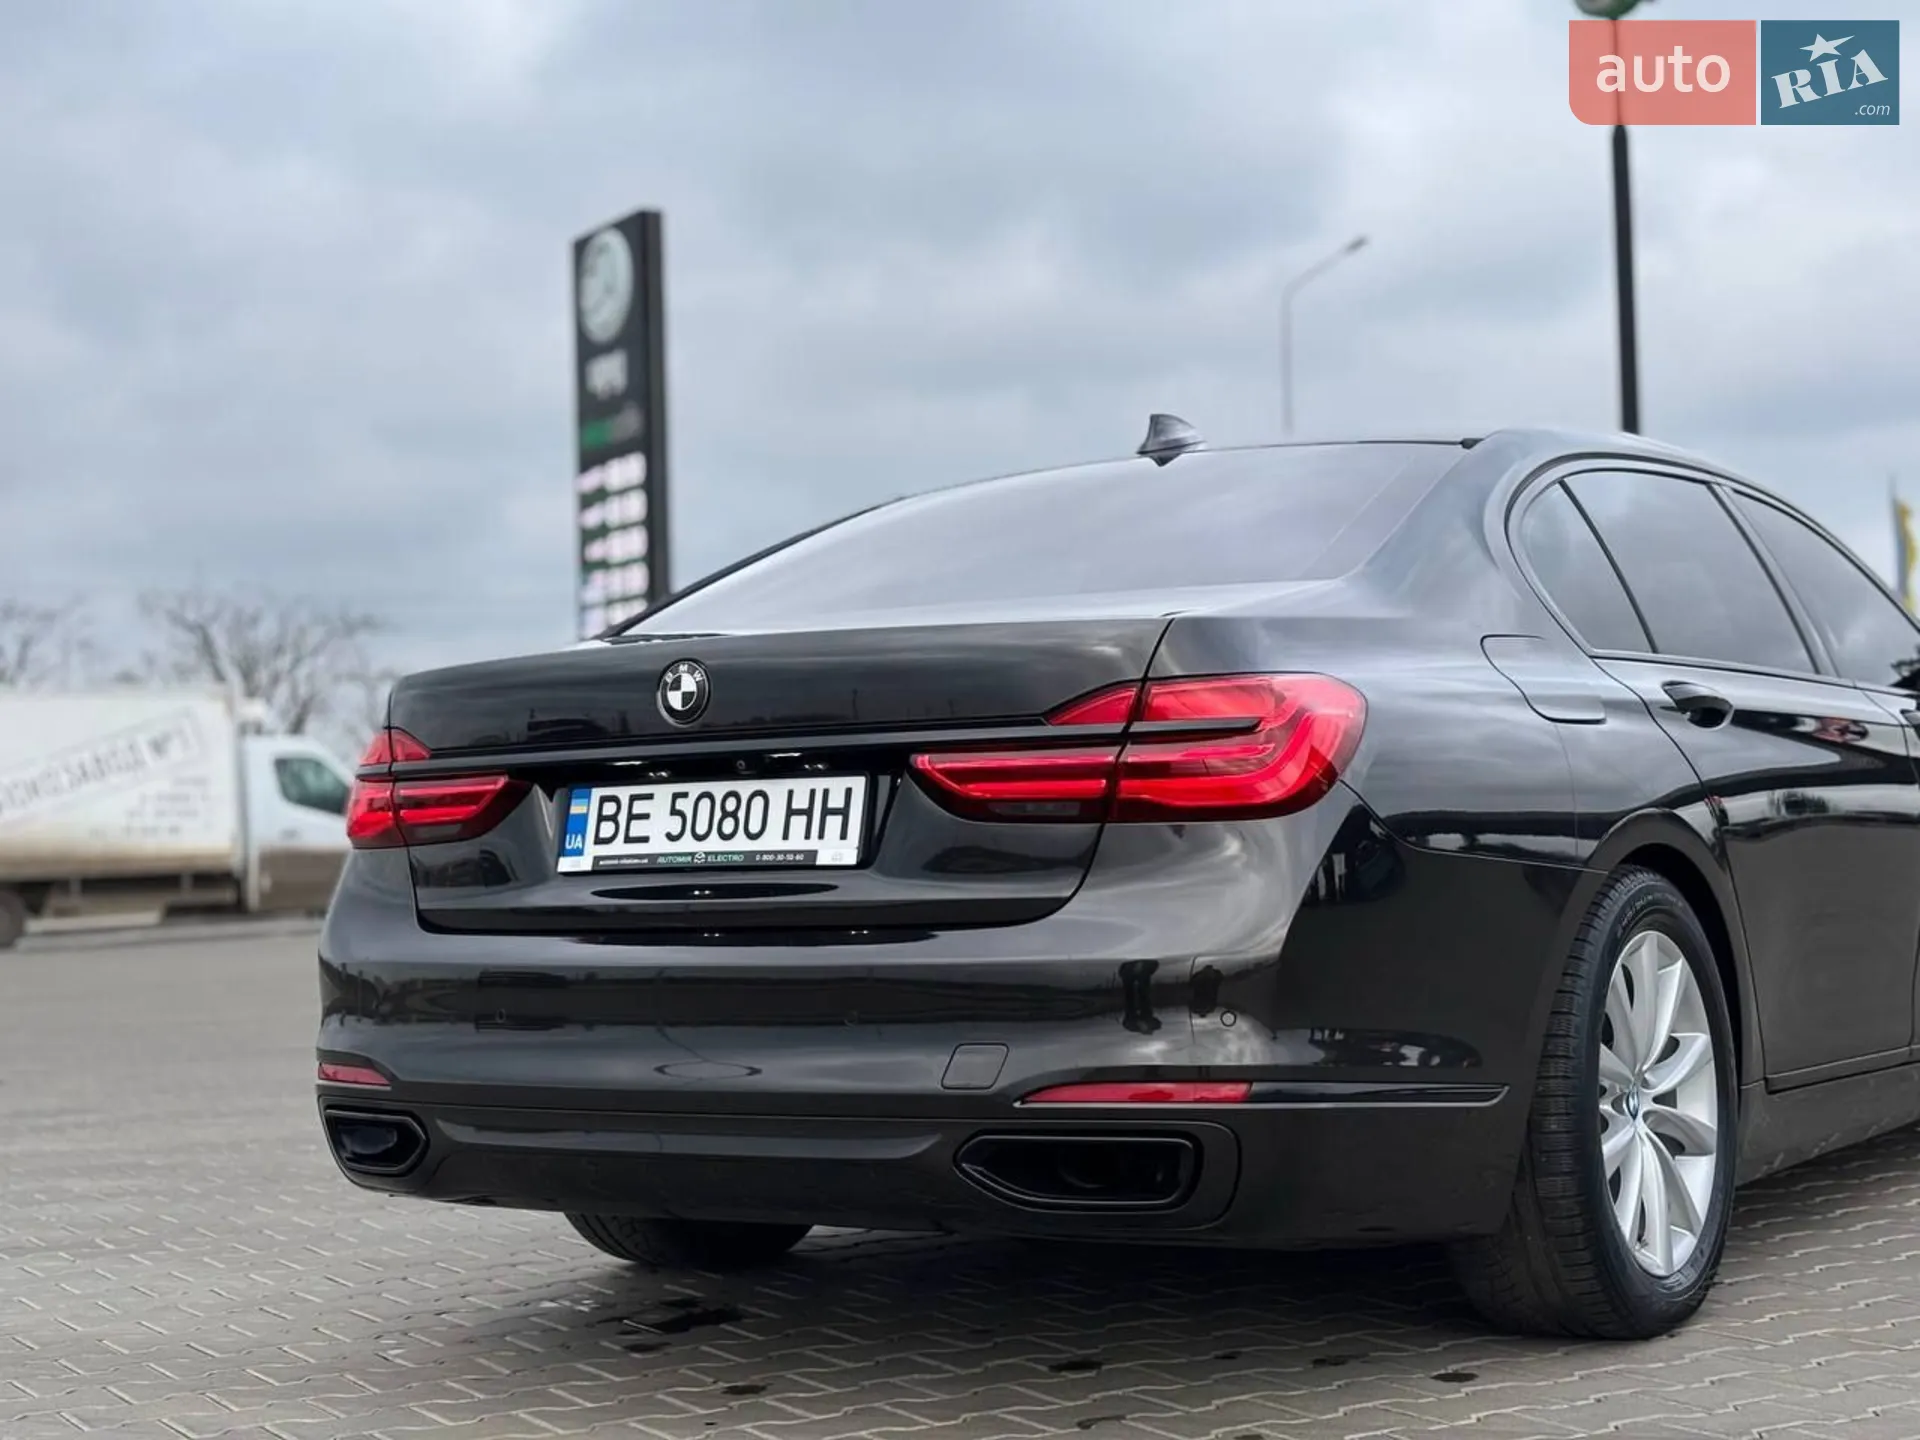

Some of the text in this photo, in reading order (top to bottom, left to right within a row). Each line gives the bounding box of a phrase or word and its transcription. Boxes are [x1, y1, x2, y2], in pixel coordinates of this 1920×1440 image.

[665, 663, 703, 683] BMW
[593, 787, 853, 846] BE 5080 HH
[565, 833, 583, 850] UA
[656, 855, 692, 864] AUTOMIR
[707, 854, 745, 862] ELECTRO
